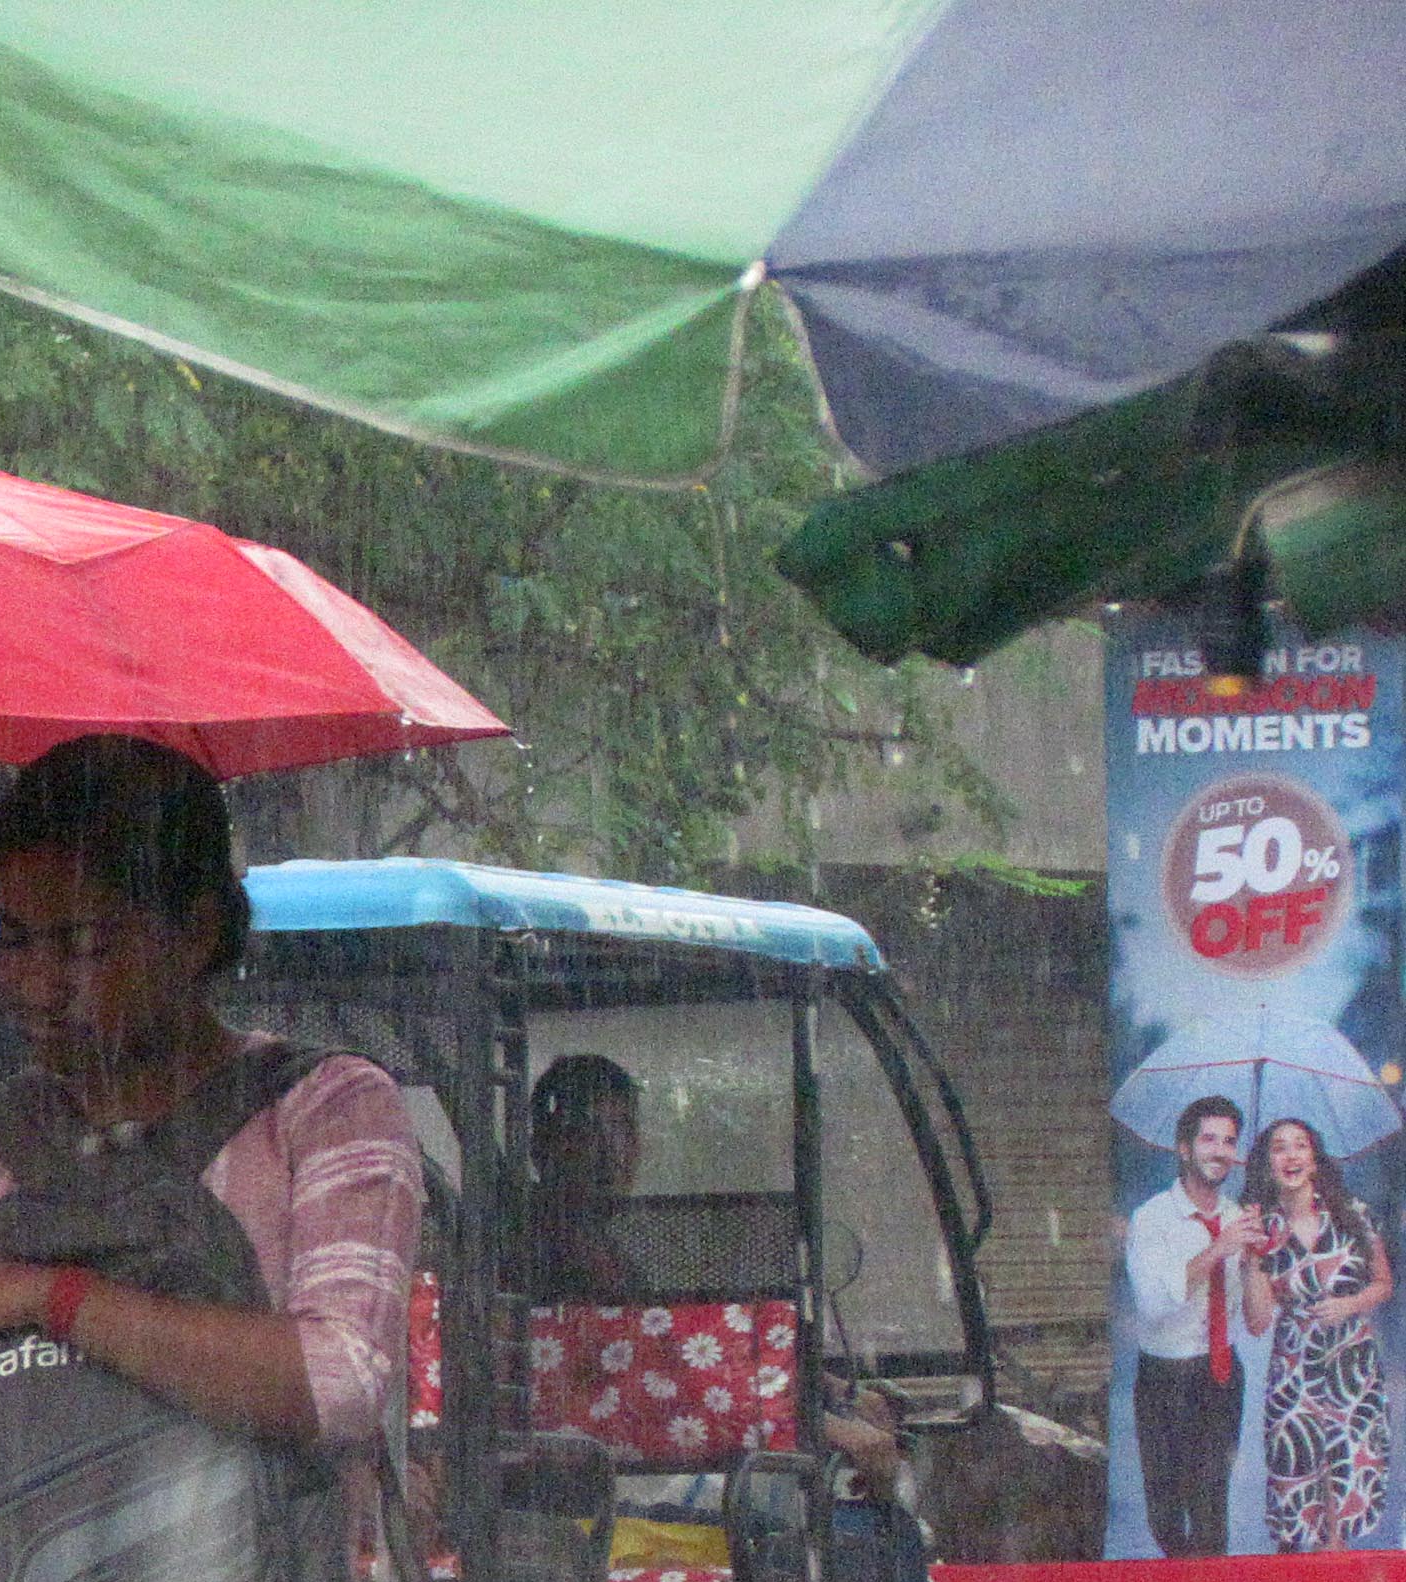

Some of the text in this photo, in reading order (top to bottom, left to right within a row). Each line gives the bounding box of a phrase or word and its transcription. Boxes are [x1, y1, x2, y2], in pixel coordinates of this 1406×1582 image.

[1296, 646, 1363, 673] FOR
[1138, 712, 1372, 754] MOMENTS
[1199, 796, 1265, 823] UP TO
[1190, 816, 1340, 902] 50%
[1192, 883, 1328, 958] OFF
